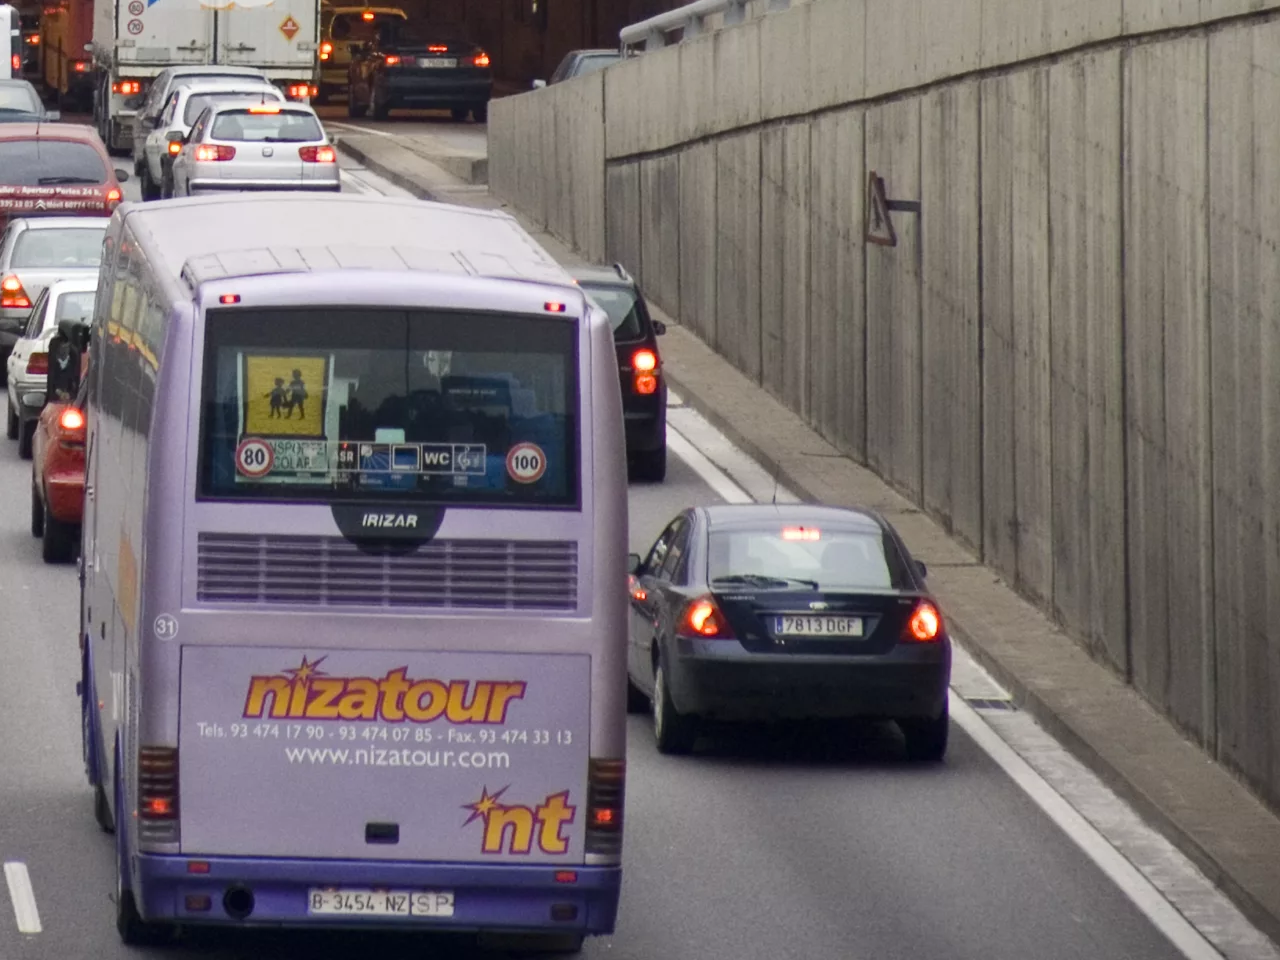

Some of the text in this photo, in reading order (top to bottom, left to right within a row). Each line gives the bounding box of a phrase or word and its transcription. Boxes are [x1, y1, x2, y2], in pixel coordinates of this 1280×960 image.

[131, 22, 141, 32] 70
[244, 448, 265, 465] 80
[424, 452, 450, 465] WC
[513, 454, 538, 471] 100
[362, 513, 418, 528] IRIZAR
[156, 620, 174, 634] 31
[784, 617, 856, 633] 7813 DGF
[243, 658, 526, 724] nizatour
[197, 722, 573, 745] Tels. 93 474 17 90 93 474 07 85 Fax. 93 474 33 13
[285, 745, 510, 769] www.nizatour.com
[480, 788, 577, 855] nt
